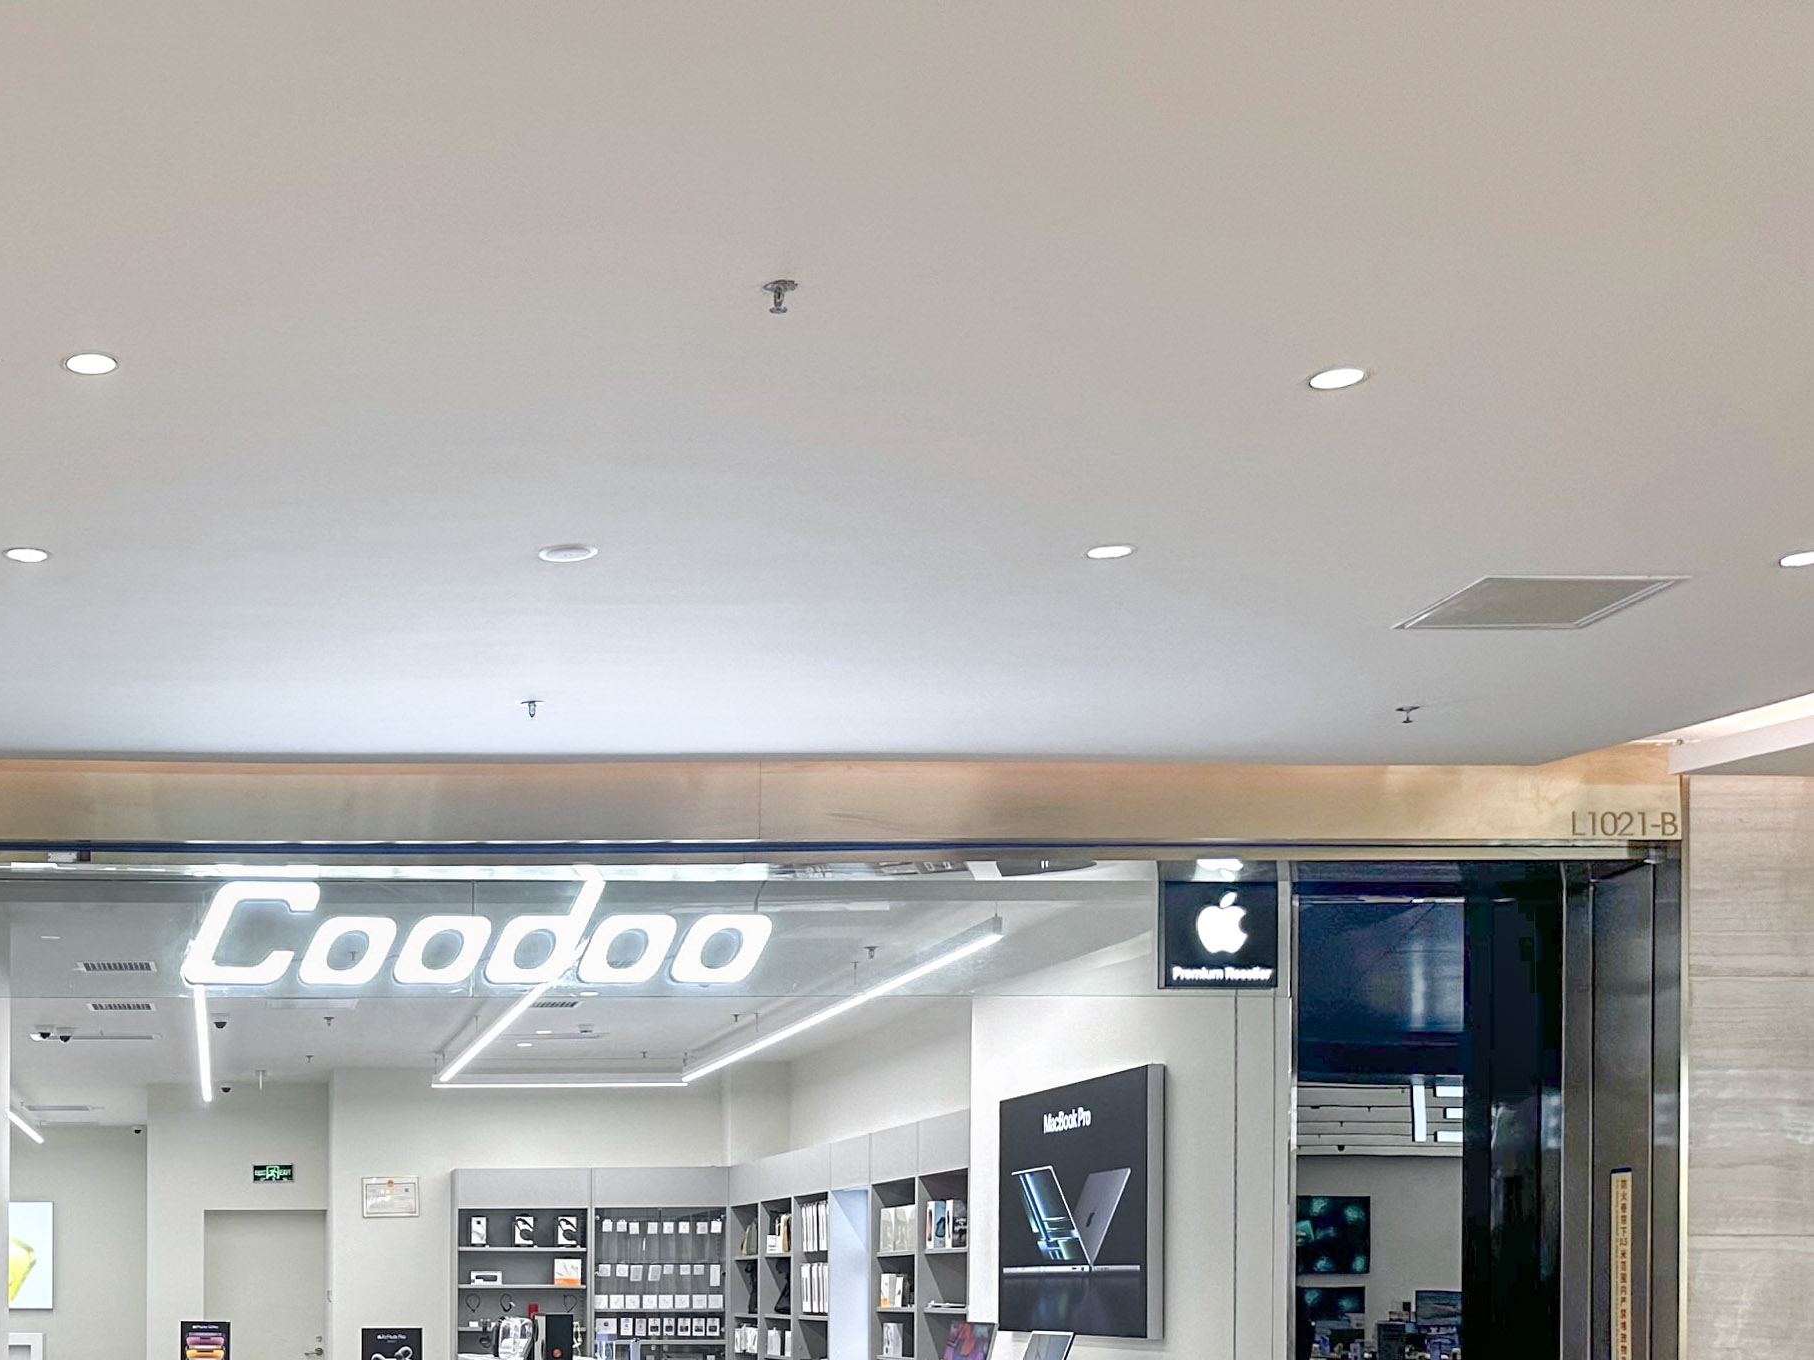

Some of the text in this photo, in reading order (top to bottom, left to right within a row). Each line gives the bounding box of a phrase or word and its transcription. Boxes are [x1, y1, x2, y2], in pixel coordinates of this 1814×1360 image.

[1571, 810, 1679, 837] L1021-B
[183, 877, 773, 985] Coodoo
[1043, 1106, 1092, 1135] MacBook Pro
